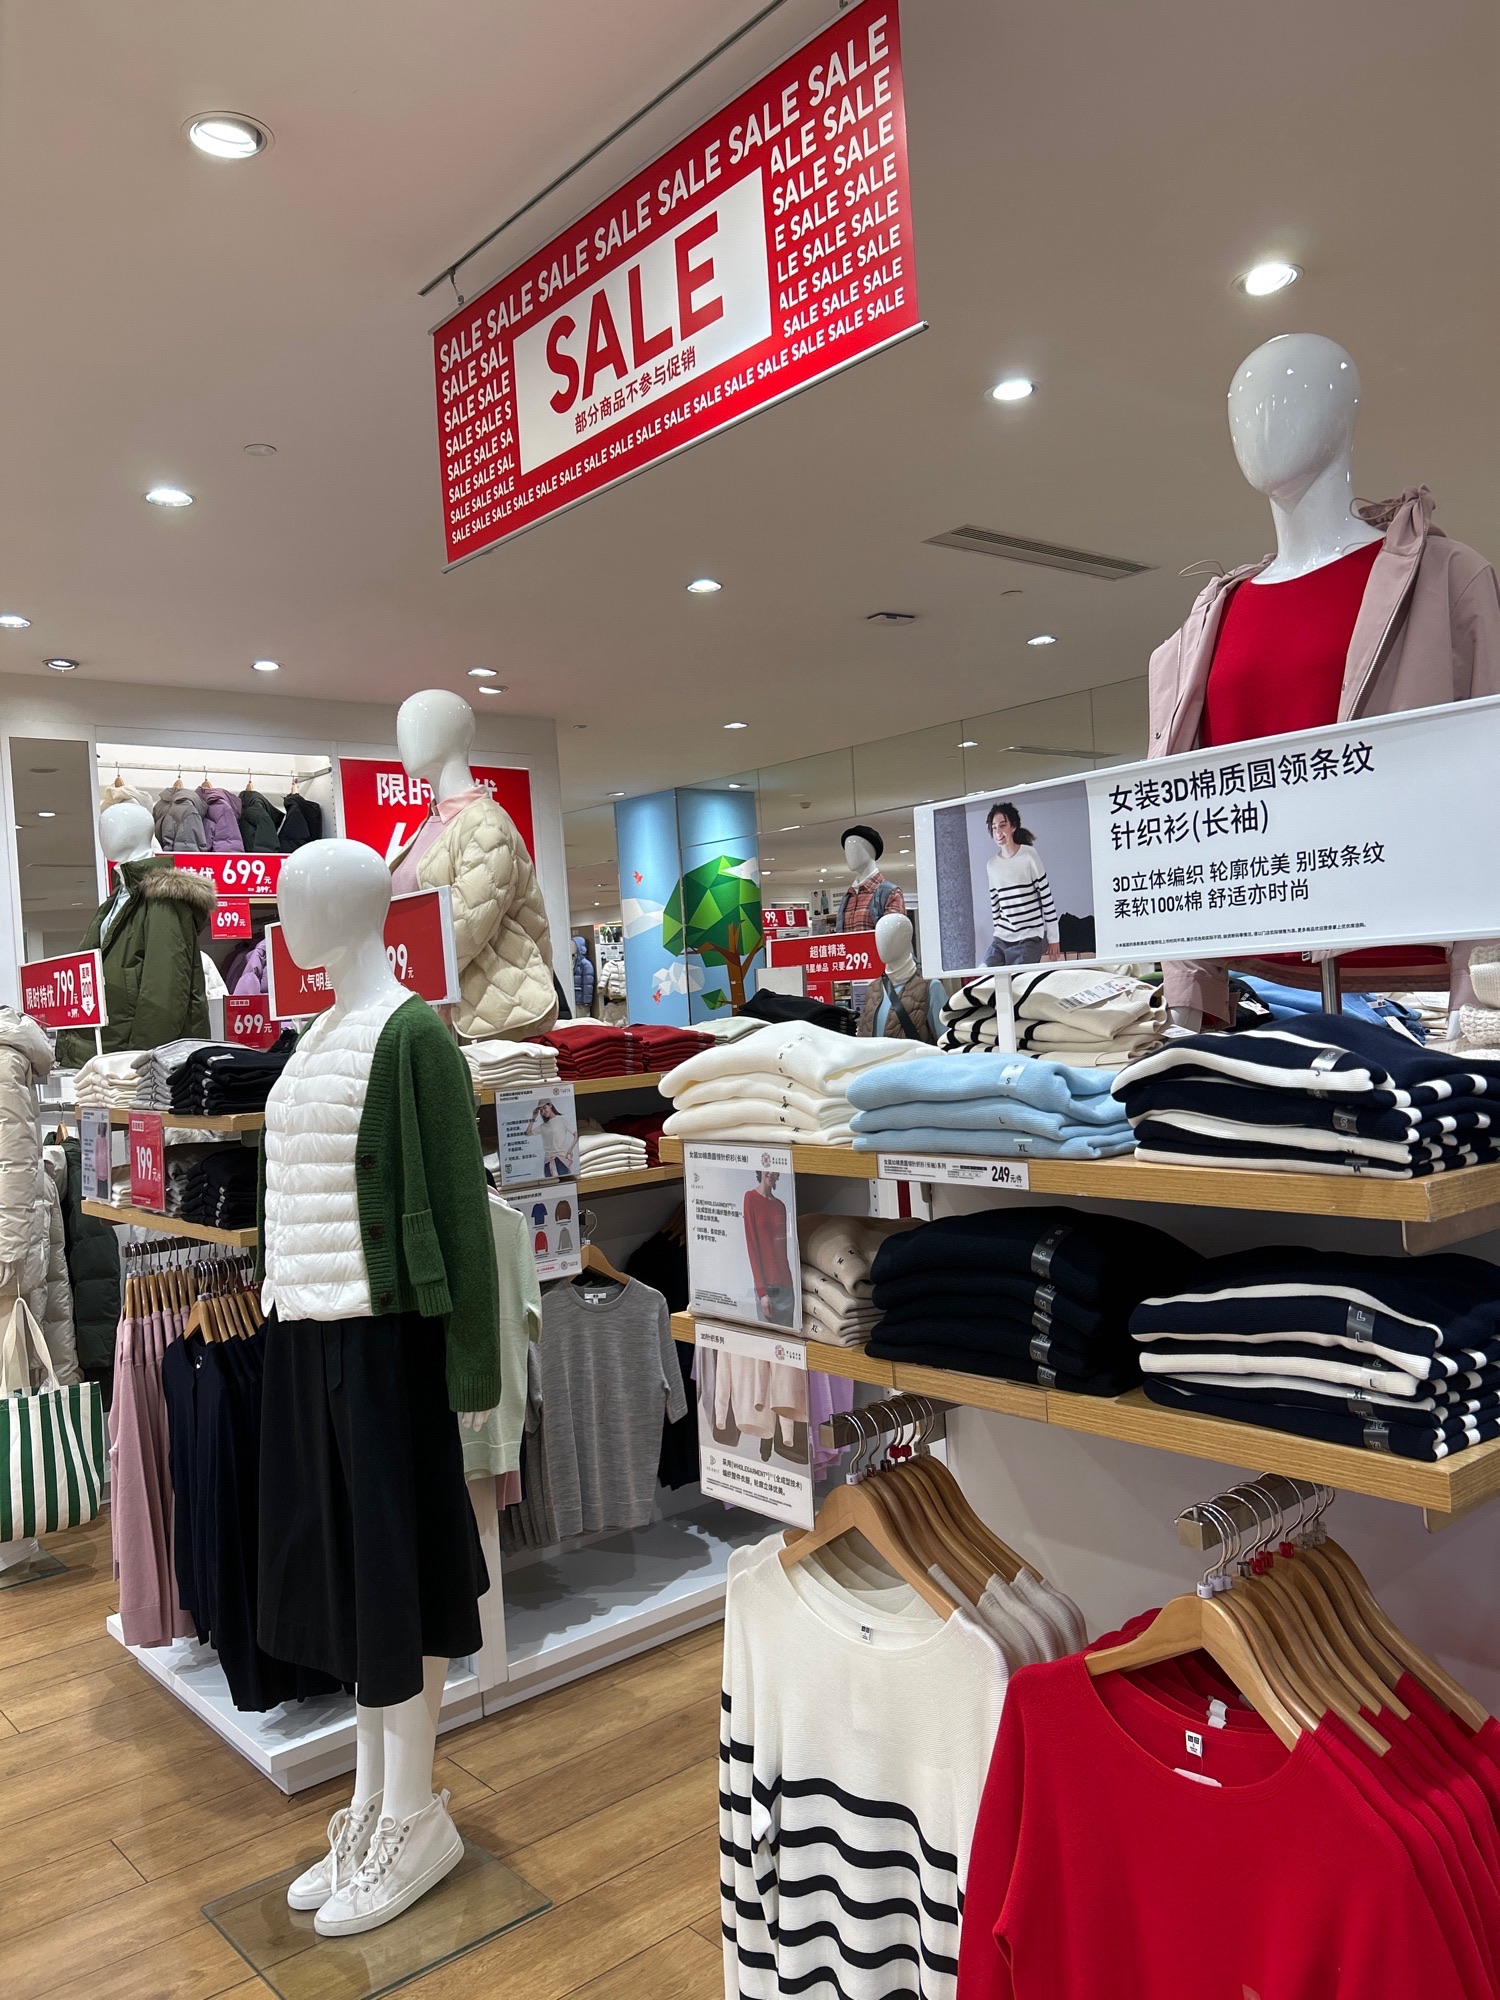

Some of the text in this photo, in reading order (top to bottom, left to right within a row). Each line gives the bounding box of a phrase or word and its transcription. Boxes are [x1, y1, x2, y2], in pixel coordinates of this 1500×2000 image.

[824, 66, 891, 140] SALE
[441, 15, 888, 372] SALE SALE SALE SALE SALE SALE SALE
[773, 111, 894, 216] SALE SALE
[791, 189, 839, 240] SALE
[844, 153, 896, 207] SALE
[803, 222, 847, 266] SALE
[851, 189, 899, 237] SALE
[812, 252, 853, 292] SALE
[857, 224, 901, 267] SALE
[546, 210, 725, 414] SALE
[784, 256, 903, 338] SALE SALE SALE
[443, 360, 477, 404] SALE
[445, 370, 510, 432] SALE SALE
[575, 345, 696, 434] 部分商品不参与促销
[446, 426, 473, 457] SALE
[475, 406, 502, 439] SALE
[452, 287, 904, 544] SALE SALE SALE SALE SALE SALE SALE SALE SALE SALE SALE SALE SALE SALE SALE SALE
[448, 453, 472, 481] SALE
[474, 436, 498, 465] SALE
[449, 478, 471, 503] SALE
[473, 463, 495, 489] SALE
[451, 476, 514, 524] SALE SALE SALE
[1108, 740, 1375, 815] 女装3D棉质圆领条纹
[1110, 799, 1270, 851] 针织衫(长袖)
[1112, 840, 1386, 893] 3D立体编织 轮廓优美 别致条纹
[1114, 877, 1310, 919] 柔软100%棉 舒适亦时尚
[809, 943, 847, 959] 超值精选
[1018, 1143, 1029, 1153] XL
